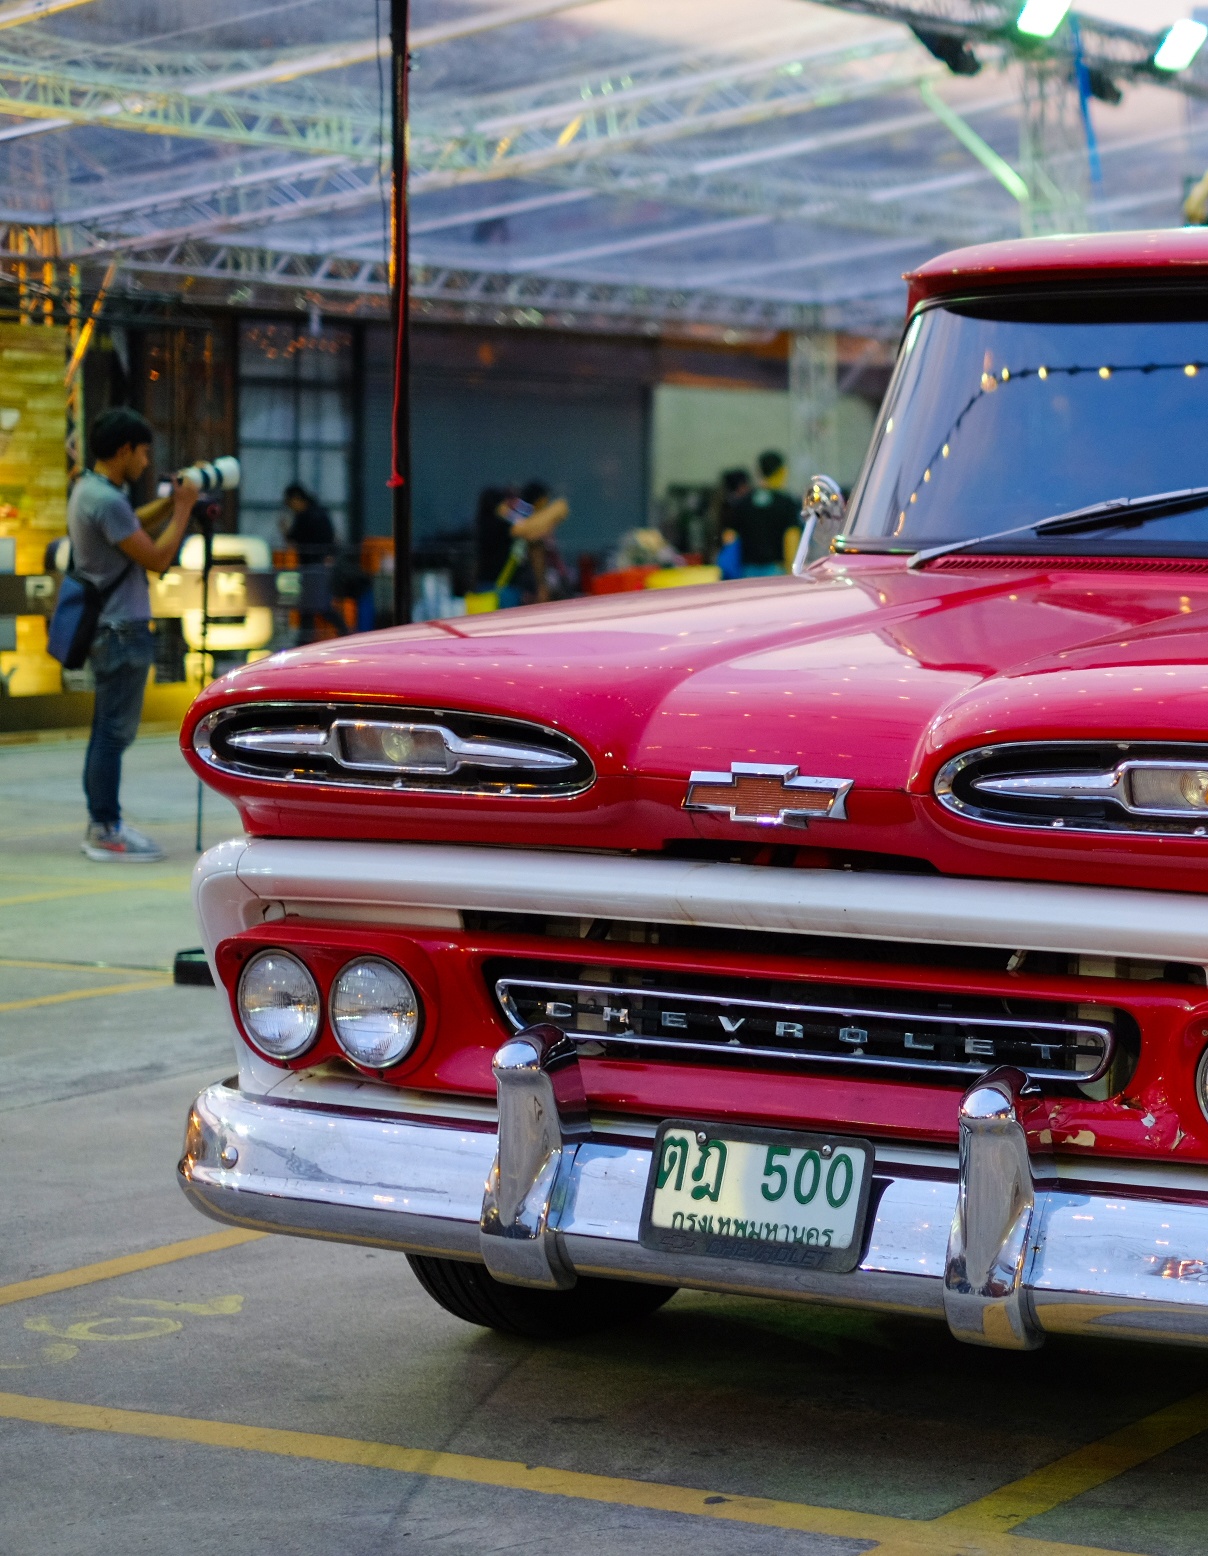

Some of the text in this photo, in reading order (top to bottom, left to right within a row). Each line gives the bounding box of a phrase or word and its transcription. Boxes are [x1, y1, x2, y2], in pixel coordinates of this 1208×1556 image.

[545, 1000, 1064, 1061] CHEVROLET
[761, 1145, 854, 1209] 500
[672, 1211, 834, 1246] กรงเทพมหานคร
[706, 1239, 833, 1270] CHEVROLET
